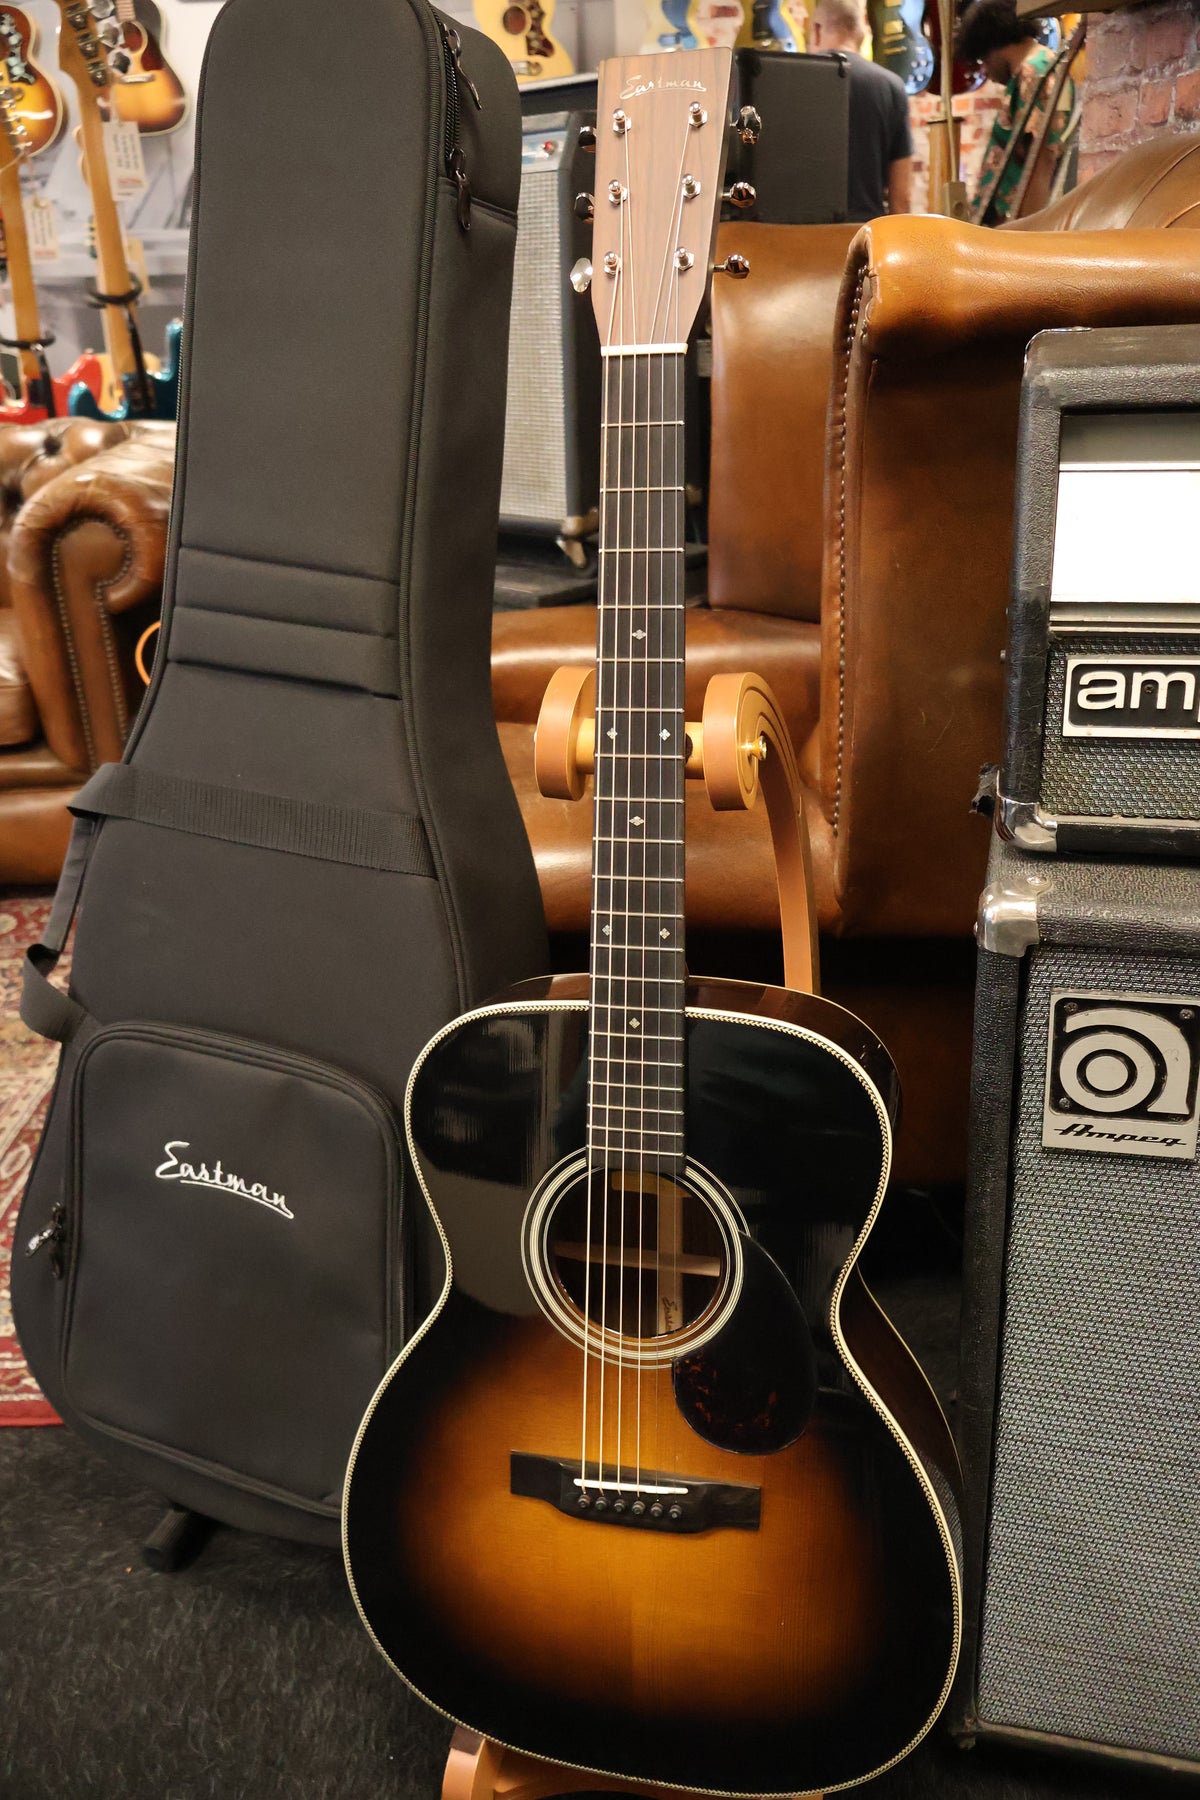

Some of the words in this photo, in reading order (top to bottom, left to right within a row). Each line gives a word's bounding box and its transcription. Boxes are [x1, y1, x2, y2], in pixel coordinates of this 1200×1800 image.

[620, 75, 707, 100] Eastman
[1077, 671, 1200, 723] am
[1054, 1123, 1187, 1147] Ampeg
[155, 1140, 294, 1220] Eastman
